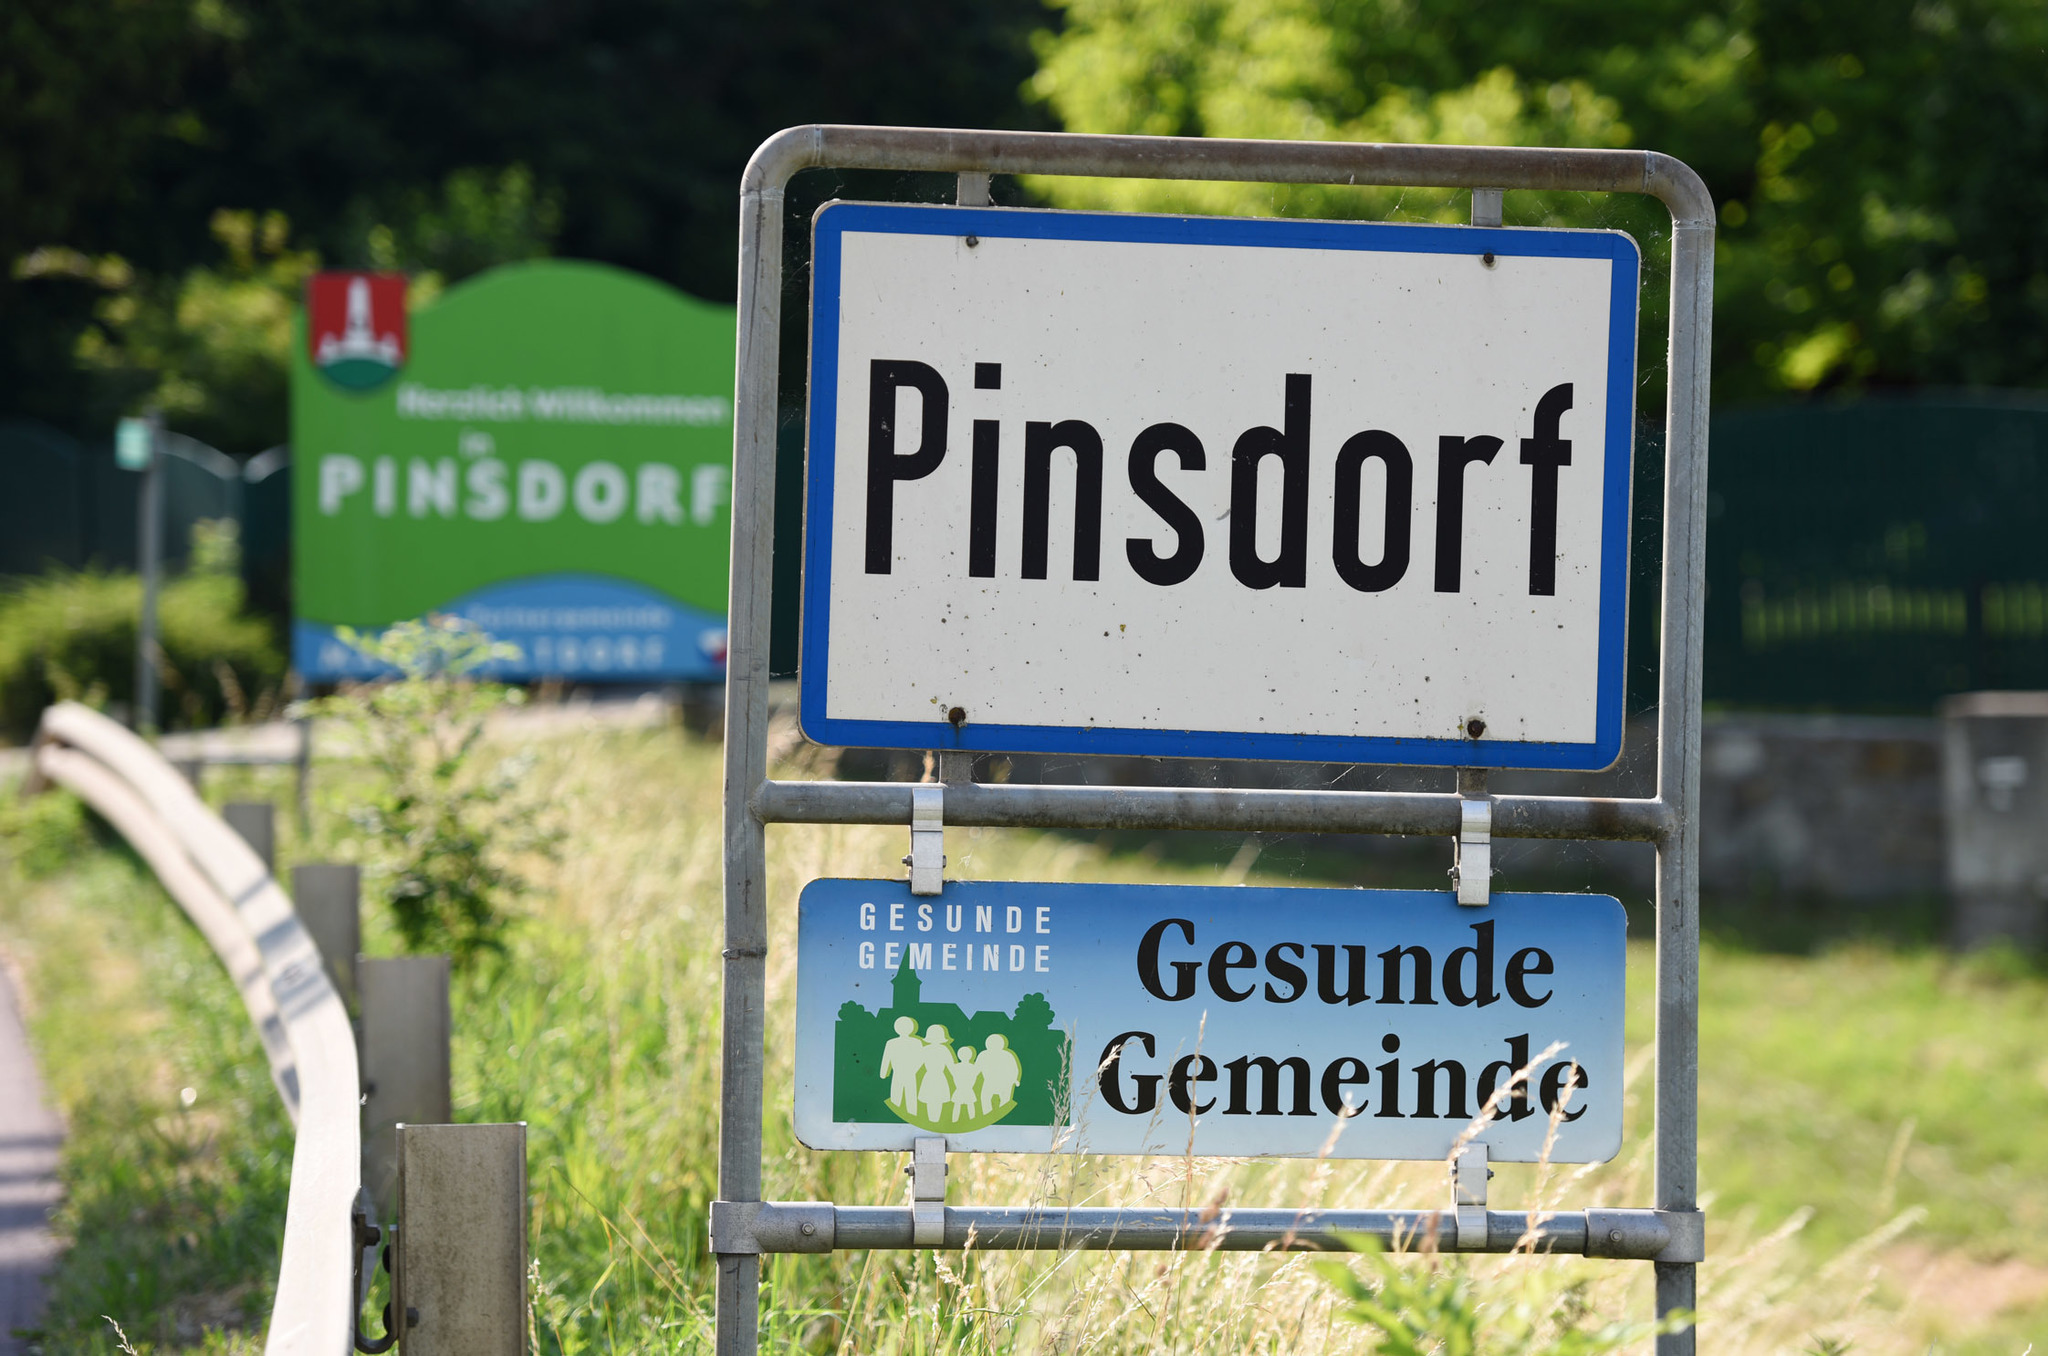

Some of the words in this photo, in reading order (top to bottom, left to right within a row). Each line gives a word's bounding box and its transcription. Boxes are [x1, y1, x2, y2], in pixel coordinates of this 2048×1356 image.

[319, 454, 731, 526] PINSDORF
[864, 358, 1574, 597] Pinsdorf
[858, 941, 1050, 973] GEMEINDE
[859, 902, 1051, 934] GESUNDE
[1136, 917, 1555, 1009] Gesunde
[1098, 1030, 1589, 1123] Gemeinde
